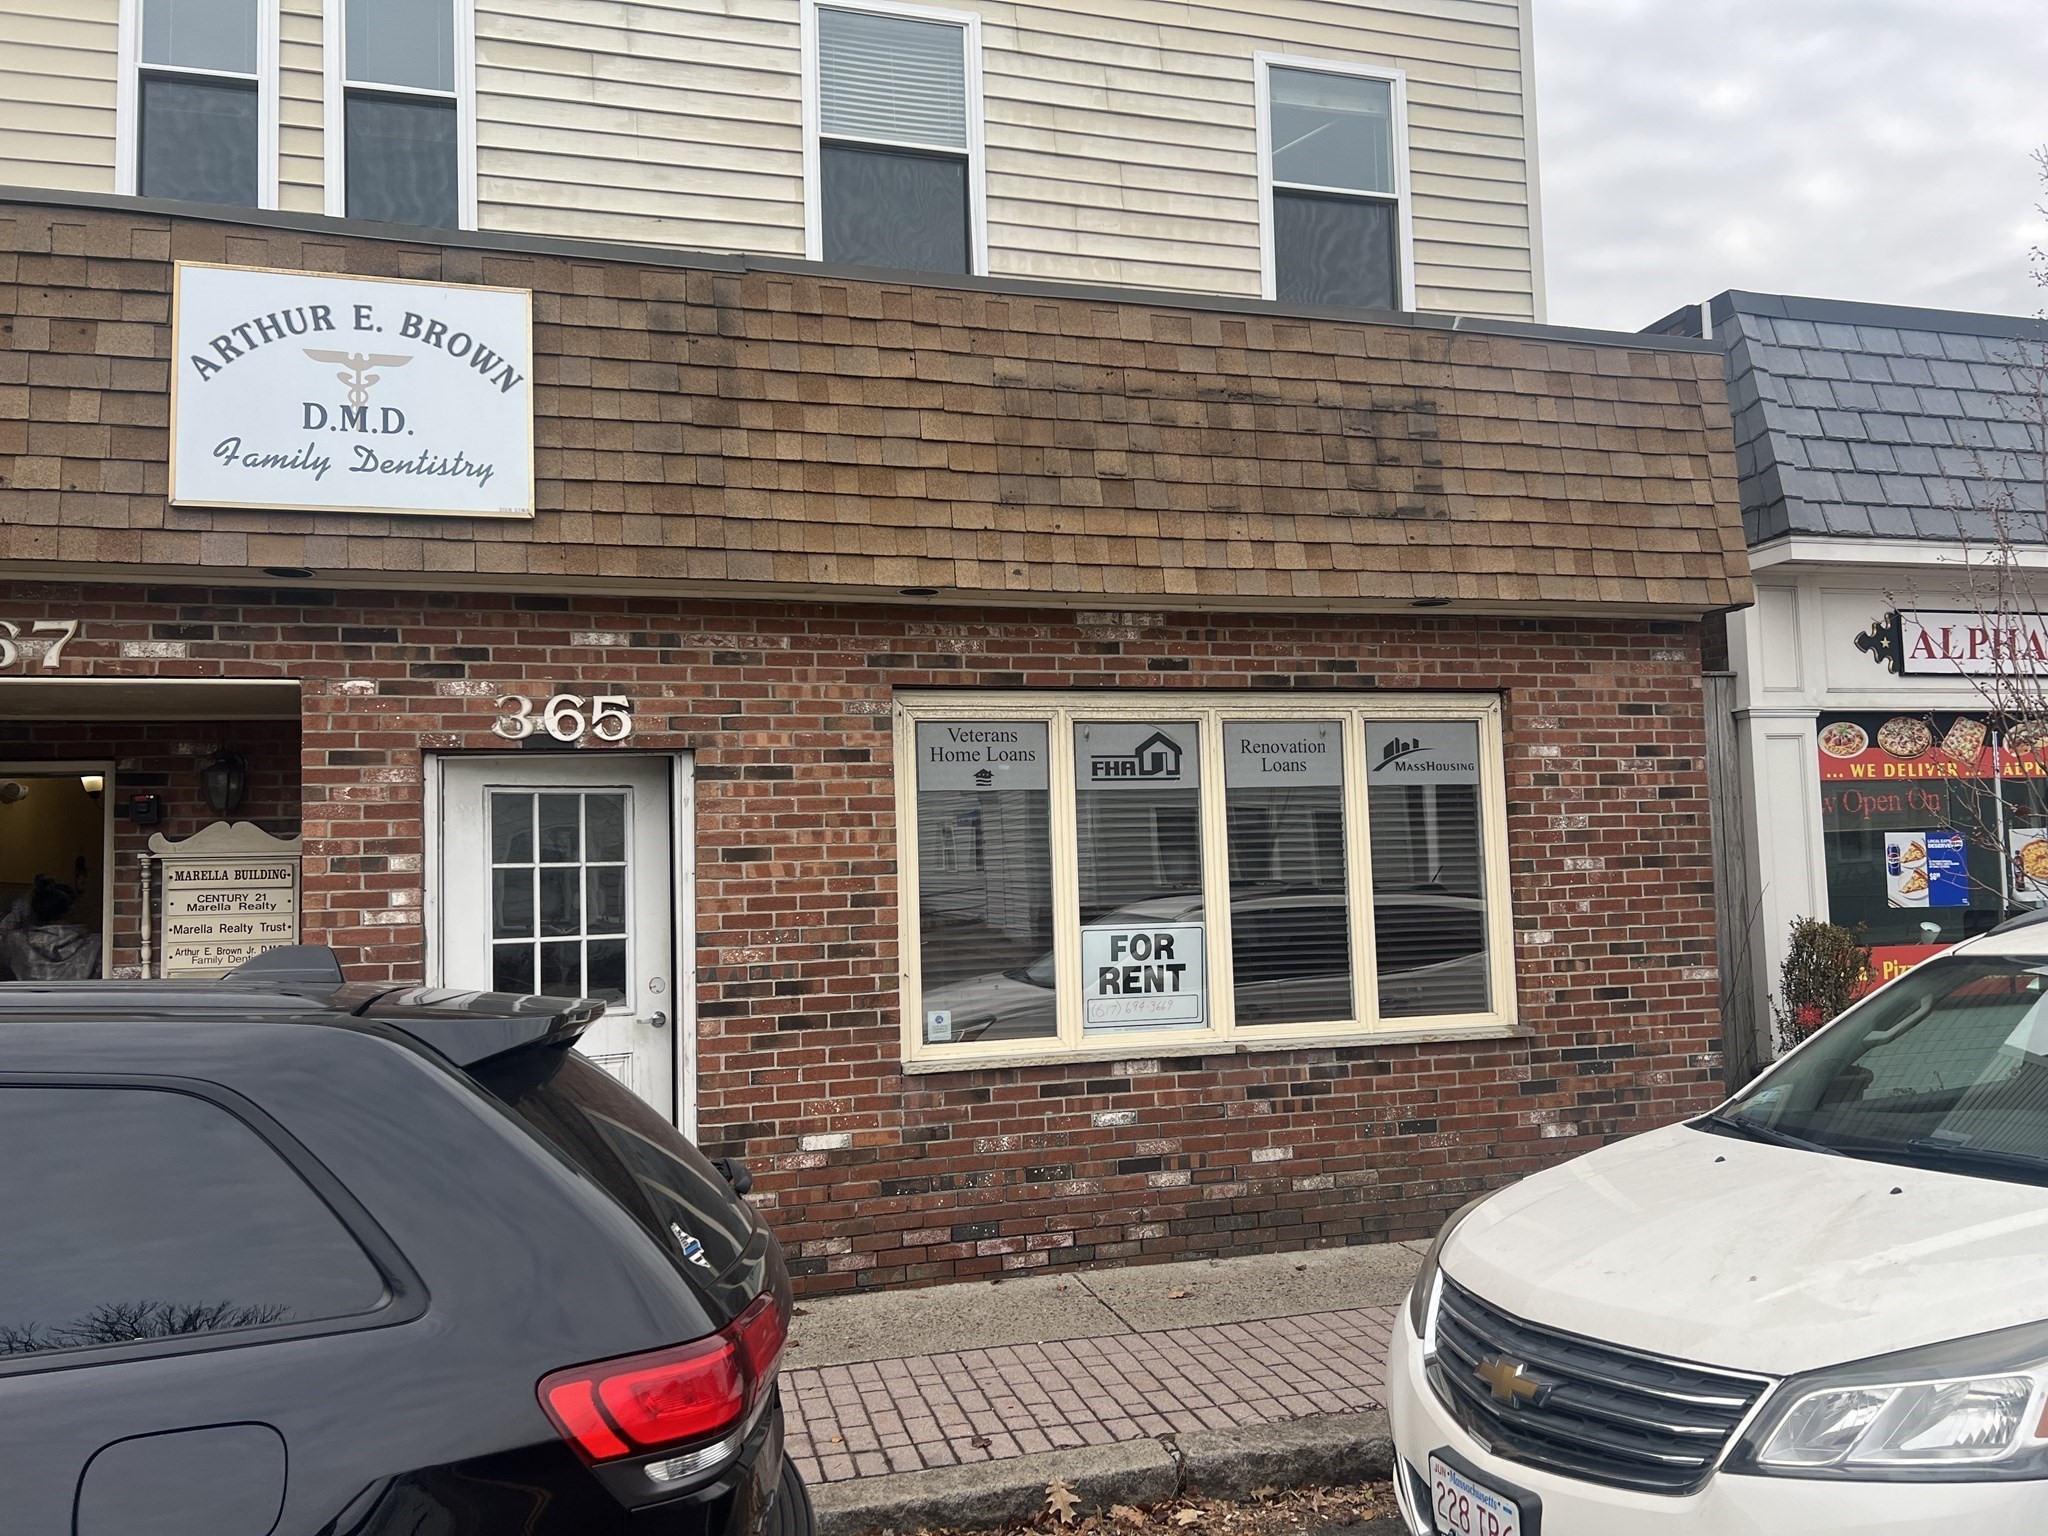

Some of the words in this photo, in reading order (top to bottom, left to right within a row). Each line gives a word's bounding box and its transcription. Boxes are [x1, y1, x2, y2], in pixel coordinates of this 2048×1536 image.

[190, 304, 336, 382] ARTHUR
[353, 305, 383, 333] E.
[399, 312, 525, 394] BROWN
[302, 402, 414, 436] D.M.D.
[213, 437, 331, 481] Family
[348, 445, 494, 488] Dentistry
[492, 694, 632, 742] 365
[947, 727, 1018, 743] Veterans
[930, 746, 981, 762] Home
[986, 746, 1036, 762] Loans
[1240, 738, 1327, 754] Renovation
[1091, 760, 1136, 776] FHA
[1261, 757, 1307, 773] Loans
[1850, 763, 1876, 778] WE
[1884, 762, 1958, 778] DELIVER
[1843, 788, 1902, 820] Open
[174, 870, 229, 881] MARELLA
[234, 869, 287, 880] BUILDING
[197, 894, 249, 903] CENTURY
[255, 893, 267, 902] 21
[186, 903, 231, 912] Marella
[239, 902, 277, 911] Realty
[173, 924, 213, 935] Marella
[219, 923, 253, 934] Realty
[260, 922, 286, 932] Trust
[175, 947, 200, 956] Arthur
[216, 946, 242, 955] Brown
[246, 946, 256, 954] Jr.
[1110, 933, 1175, 961] FOR
[191, 955, 223, 965] Family
[1099, 963, 1186, 995] RENT
[1434, 1462, 1447, 1478] JUN
[1449, 1470, 1498, 1511] Massachusetts
[1436, 1481, 1470, 1534] 228
